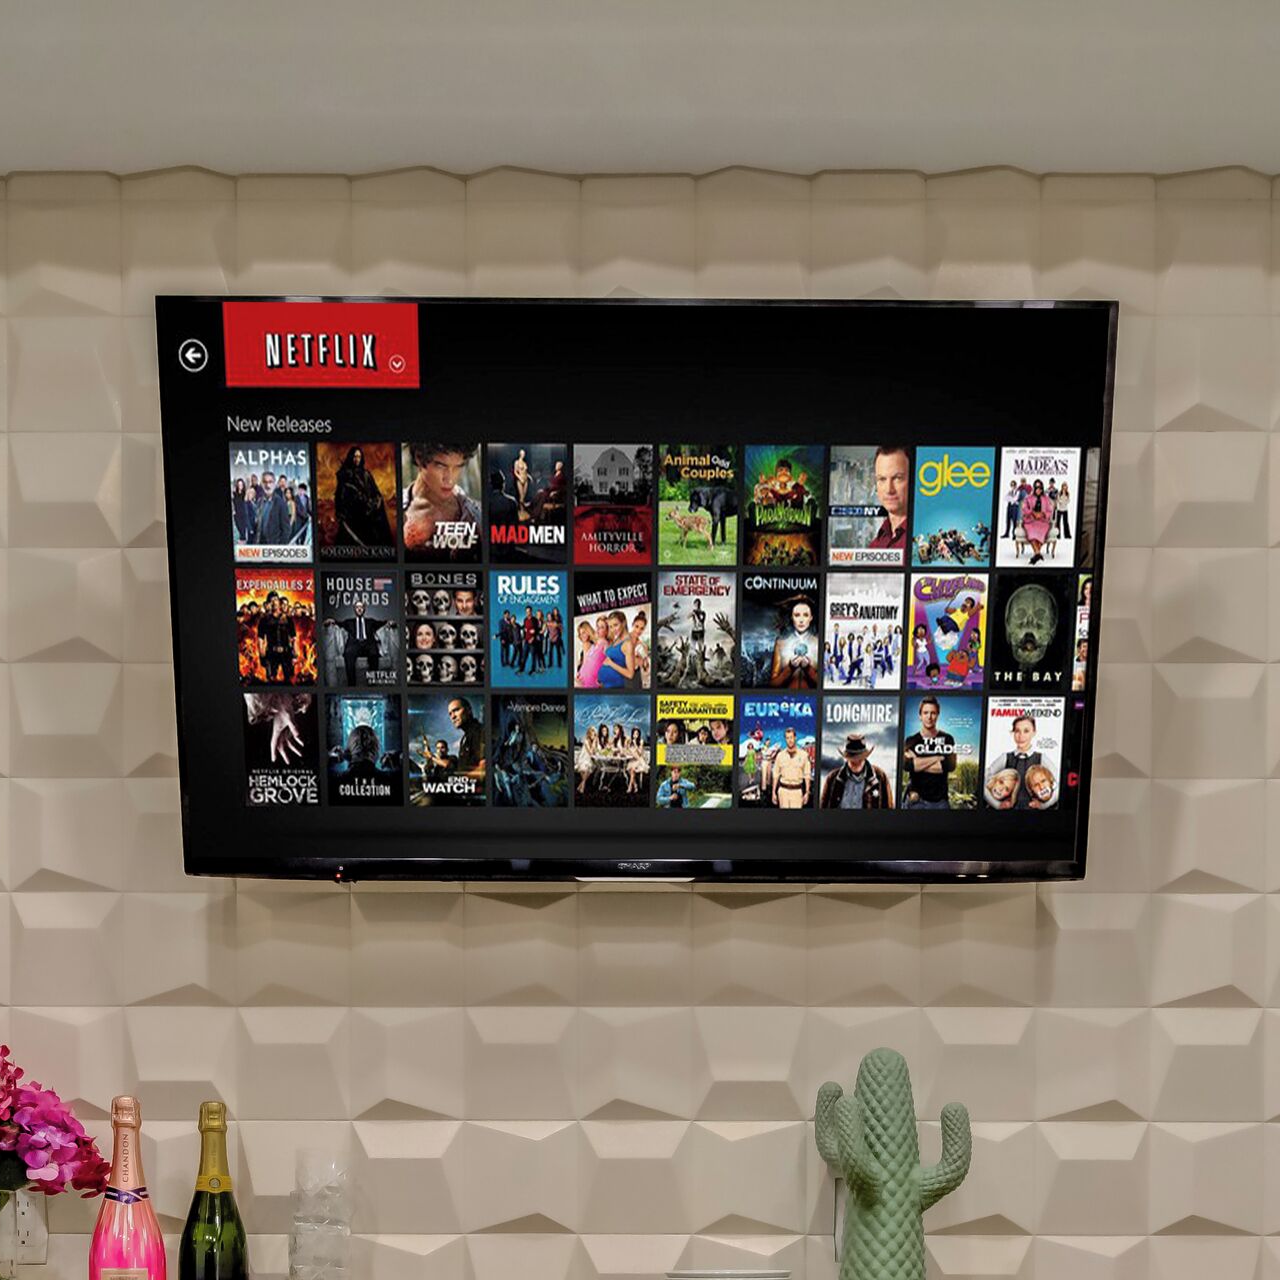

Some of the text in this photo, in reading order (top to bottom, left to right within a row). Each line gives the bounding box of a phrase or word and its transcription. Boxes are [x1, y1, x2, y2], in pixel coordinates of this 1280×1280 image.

[265, 333, 377, 369] NETFLIX
[227, 415, 332, 433] New Releases
[234, 450, 307, 466] ALPHAS
[663, 453, 711, 466] Animal
[681, 467, 734, 480] Couples
[919, 453, 991, 497] glee
[434, 521, 477, 537] TEEN
[433, 535, 479, 549] WOLF
[581, 532, 644, 542] AMITYVILLE
[238, 547, 308, 558] NEW EPISODES
[589, 543, 637, 553] HORROR
[832, 552, 901, 562] NEW EPISODES
[326, 577, 372, 591] HOUSE
[411, 572, 477, 585] BONES
[497, 575, 560, 595] RULES
[675, 575, 720, 586] STATE OF
[744, 575, 818, 590] CONTINUUM
[236, 579, 313, 592] EXPENDABLES 2
[663, 585, 731, 597] EMERGENCY
[329, 592, 390, 609] of CARDS
[577, 583, 648, 608] WHAT TO EXPECT
[829, 602, 899, 620] GREY'S ANATOMY
[365, 671, 398, 679] NETFLIX
[994, 671, 1063, 682] THE BAY
[659, 700, 689, 708] SAFETY
[659, 707, 729, 715] NOT GUARANTEED
[826, 703, 893, 723] LONGMIRE
[922, 737, 946, 746] THE
[914, 744, 972, 755] GLADES
[248, 774, 318, 788] HEMLOCK
[447, 776, 469, 784] END
[339, 784, 391, 796] COLLECTION
[422, 782, 476, 794] WATCH
[249, 787, 319, 804] GROVE
